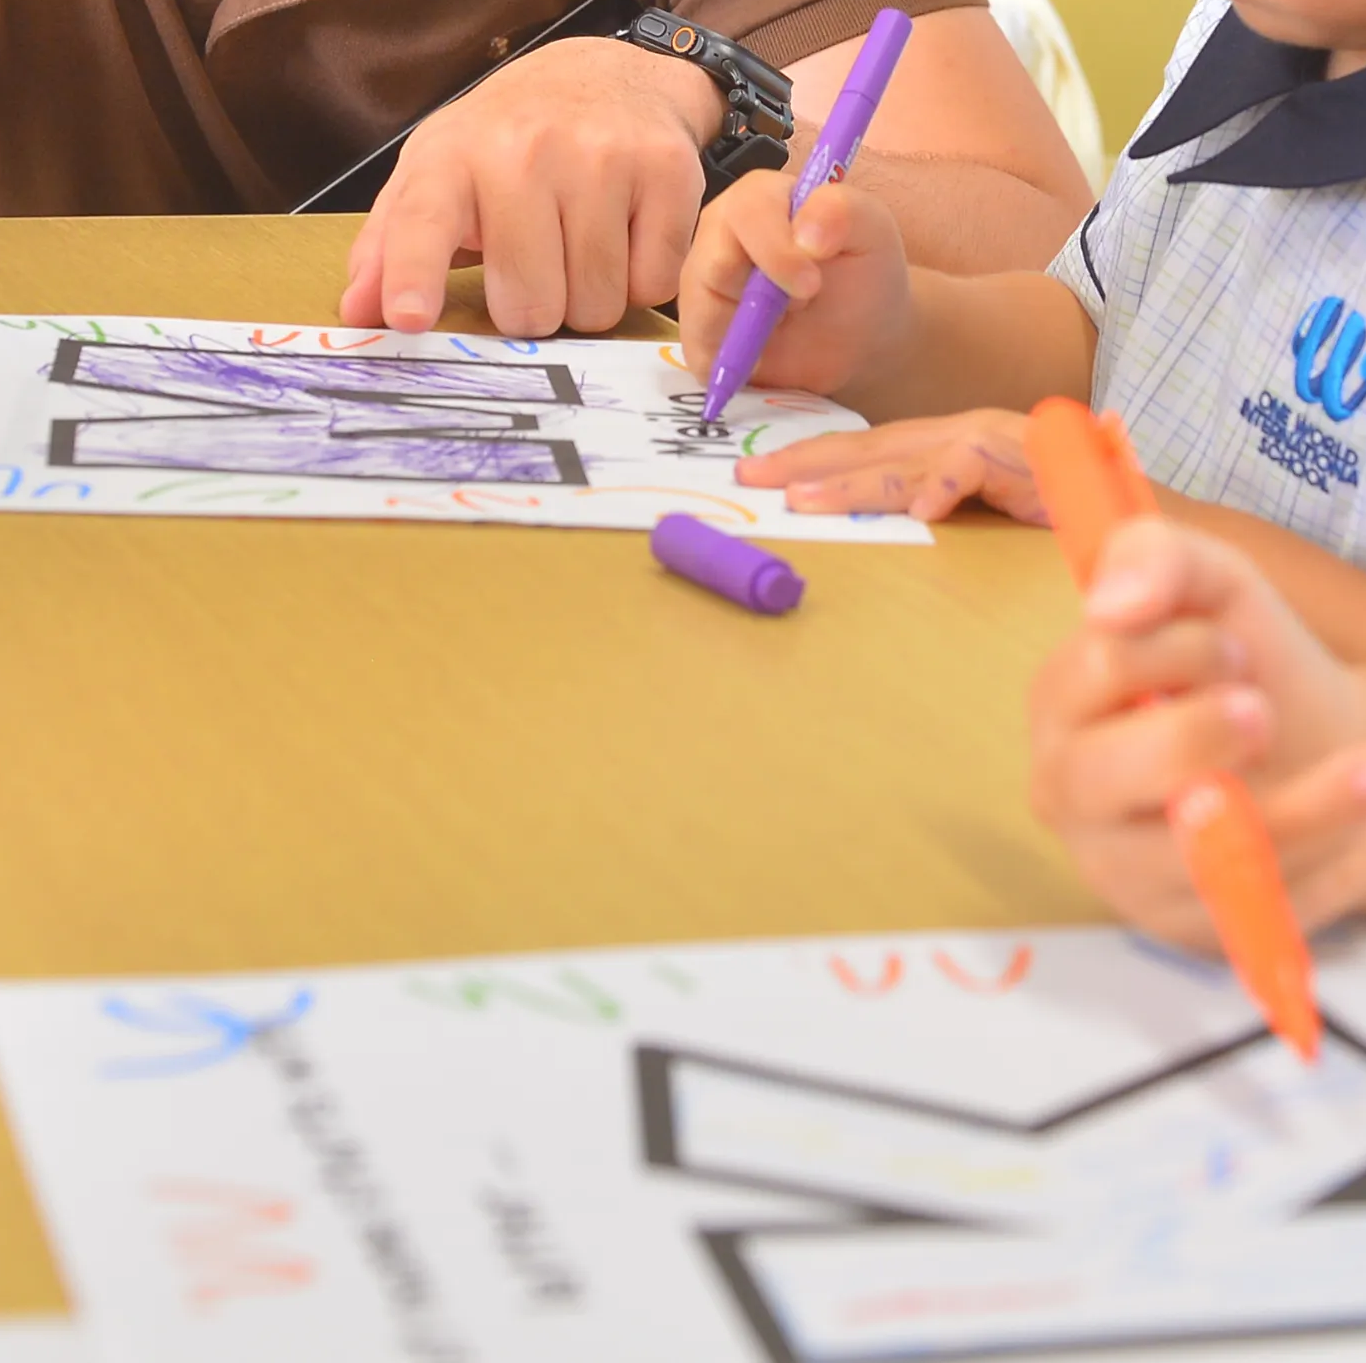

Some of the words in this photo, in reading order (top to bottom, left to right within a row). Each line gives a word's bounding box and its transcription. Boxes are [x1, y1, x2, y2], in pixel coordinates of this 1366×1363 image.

[1259, 390, 1293, 424] ONE
[1295, 412, 1358, 466] WORLD
[1258, 436, 1329, 494] SCHOOL
